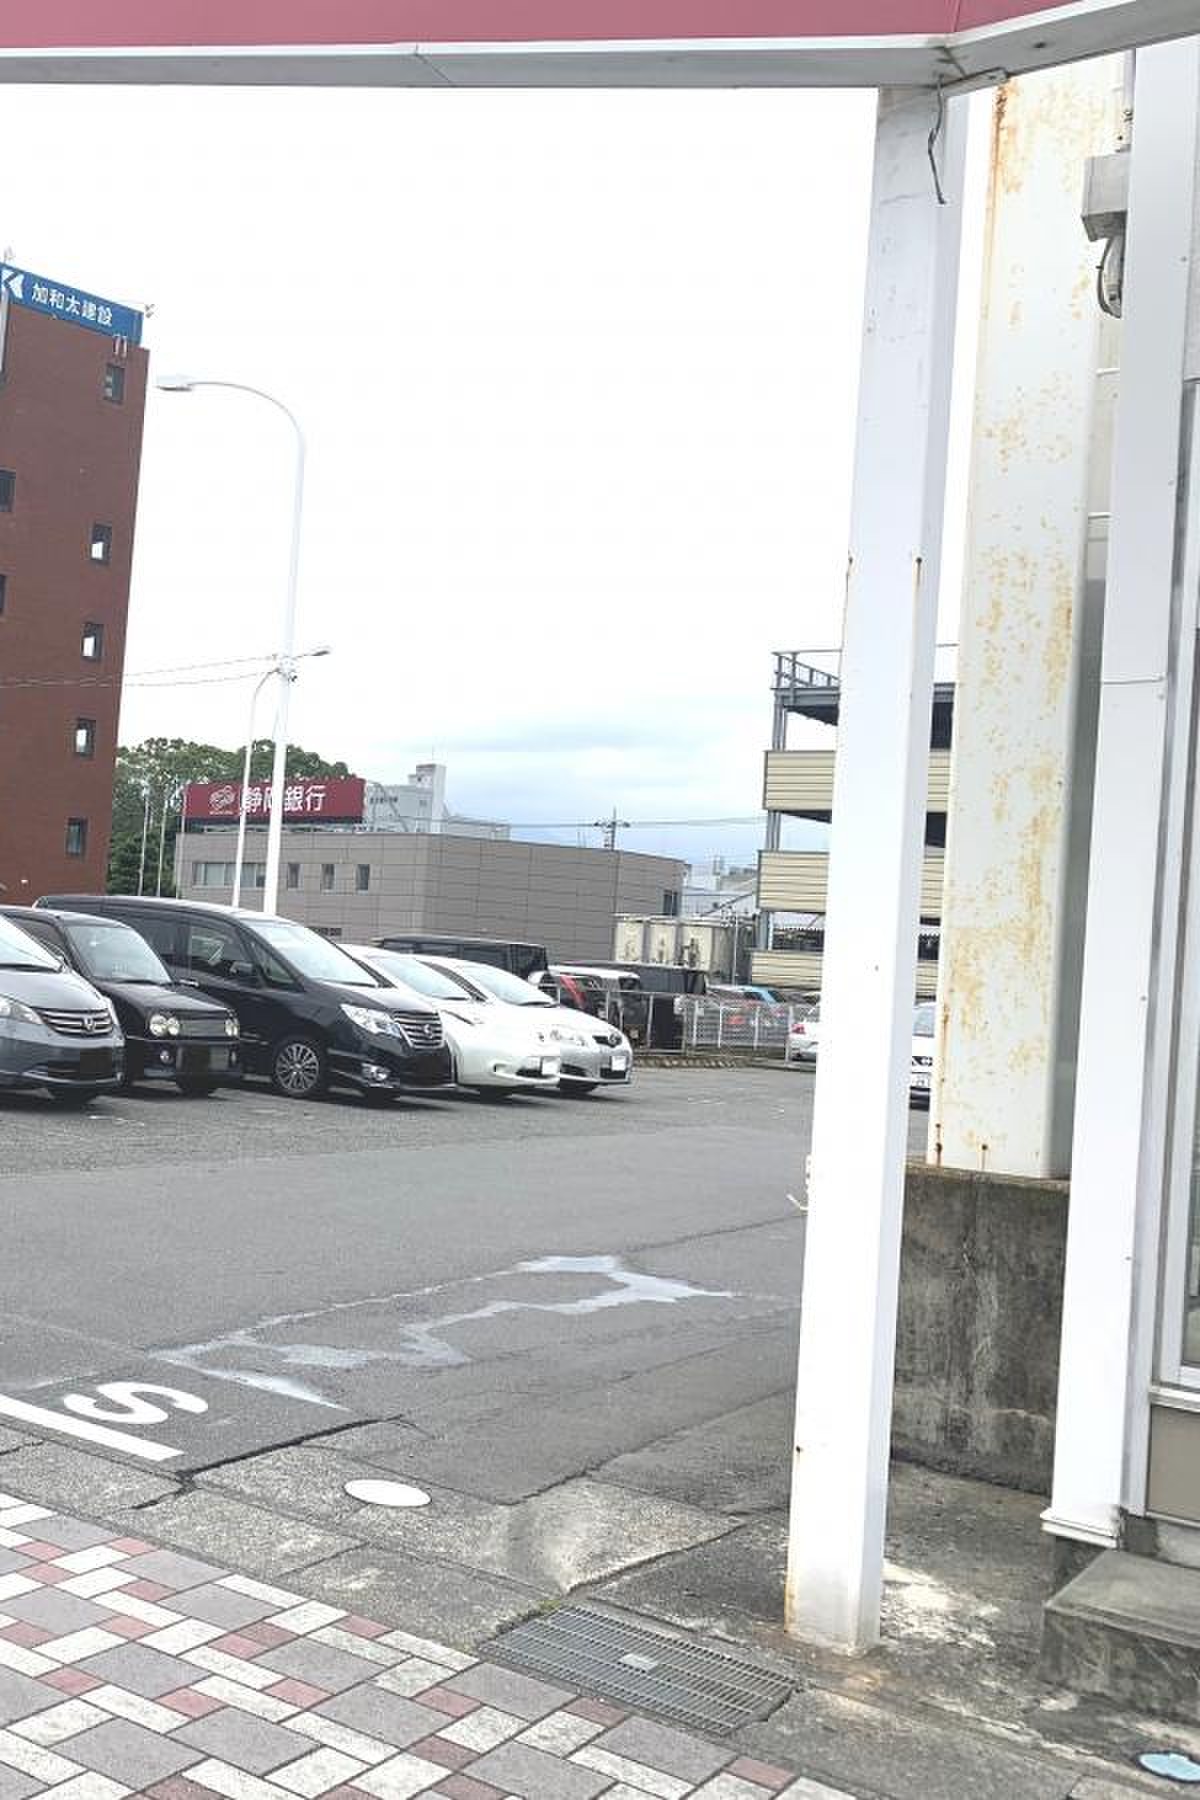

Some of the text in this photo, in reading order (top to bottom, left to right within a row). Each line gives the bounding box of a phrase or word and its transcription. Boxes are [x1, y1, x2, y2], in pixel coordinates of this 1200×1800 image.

[31, 282, 113, 327] 加和太建設
